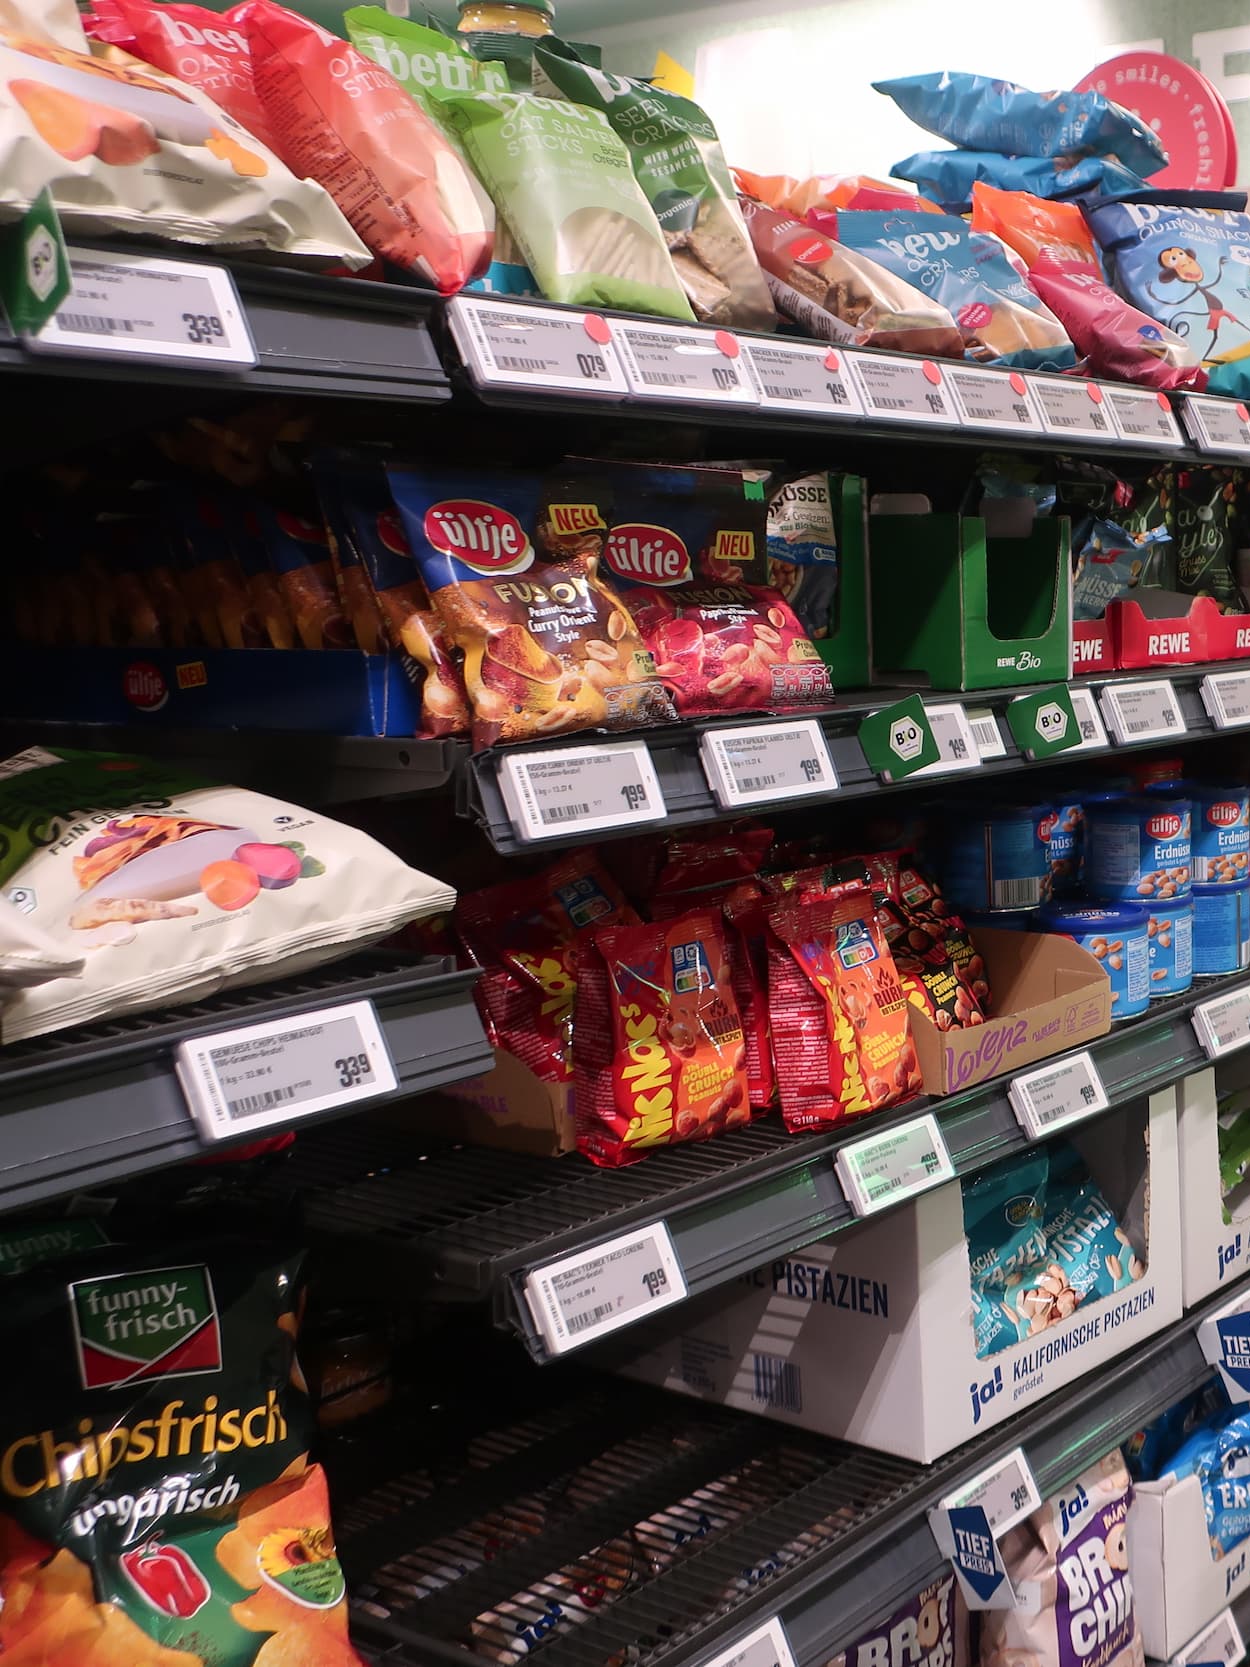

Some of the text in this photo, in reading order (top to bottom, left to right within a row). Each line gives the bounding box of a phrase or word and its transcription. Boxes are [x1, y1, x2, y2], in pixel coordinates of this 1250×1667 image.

[1114, 63, 1181, 96] smiles
[615, 98, 669, 127] SEED
[507, 134, 584, 157] STICKS
[643, 151, 671, 166] WITH
[650, 158, 688, 177] SESAME
[1138, 218, 1202, 242] QUINOA
[432, 508, 520, 555] ültje
[554, 506, 599, 532] NEU
[607, 534, 681, 576] ültje
[718, 533, 751, 558] NEU
[527, 613, 598, 635] Curry Orient
[553, 630, 581, 644] Style
[1072, 638, 1103, 662] EWE
[1148, 632, 1191, 656] REWE
[997, 650, 1042, 671] REWE Bio
[128, 671, 166, 699] ültje
[800, 758, 822, 782] 1.99
[621, 783, 647, 810] 1.99
[1150, 816, 1179, 836] ültje
[1210, 805, 1239, 822] ültje
[48, 821, 91, 855] FEIN
[932, 974, 959, 997] CRUNCH
[867, 1032, 907, 1061] CRUNCH
[335, 1052, 371, 1088] 3.39
[682, 1062, 720, 1085] DOUBLE
[687, 1065, 735, 1094] CRUNCH
[1217, 1233, 1242, 1281] ja!
[641, 1267, 667, 1298] 1.99
[771, 1259, 889, 1319] PISTAZIEN
[88, 1281, 189, 1315] funny-
[104, 1303, 197, 1342] frisch
[969, 1365, 1004, 1425] ja!
[1012, 1317, 1101, 1383] KALIFORNISCHE
[1102, 1286, 1155, 1333] PISTAZIEN
[1012, 1373, 1044, 1402] geröstet
[1, 1389, 288, 1498] Chipsfrisch
[70, 1473, 242, 1546] ungarisch
[1059, 1483, 1089, 1538] ja!
[1102, 1497, 1128, 1530] mini
[954, 1528, 991, 1556] TIEF
[963, 1554, 992, 1575] PREIS
[1225, 1553, 1246, 1598] ja!
